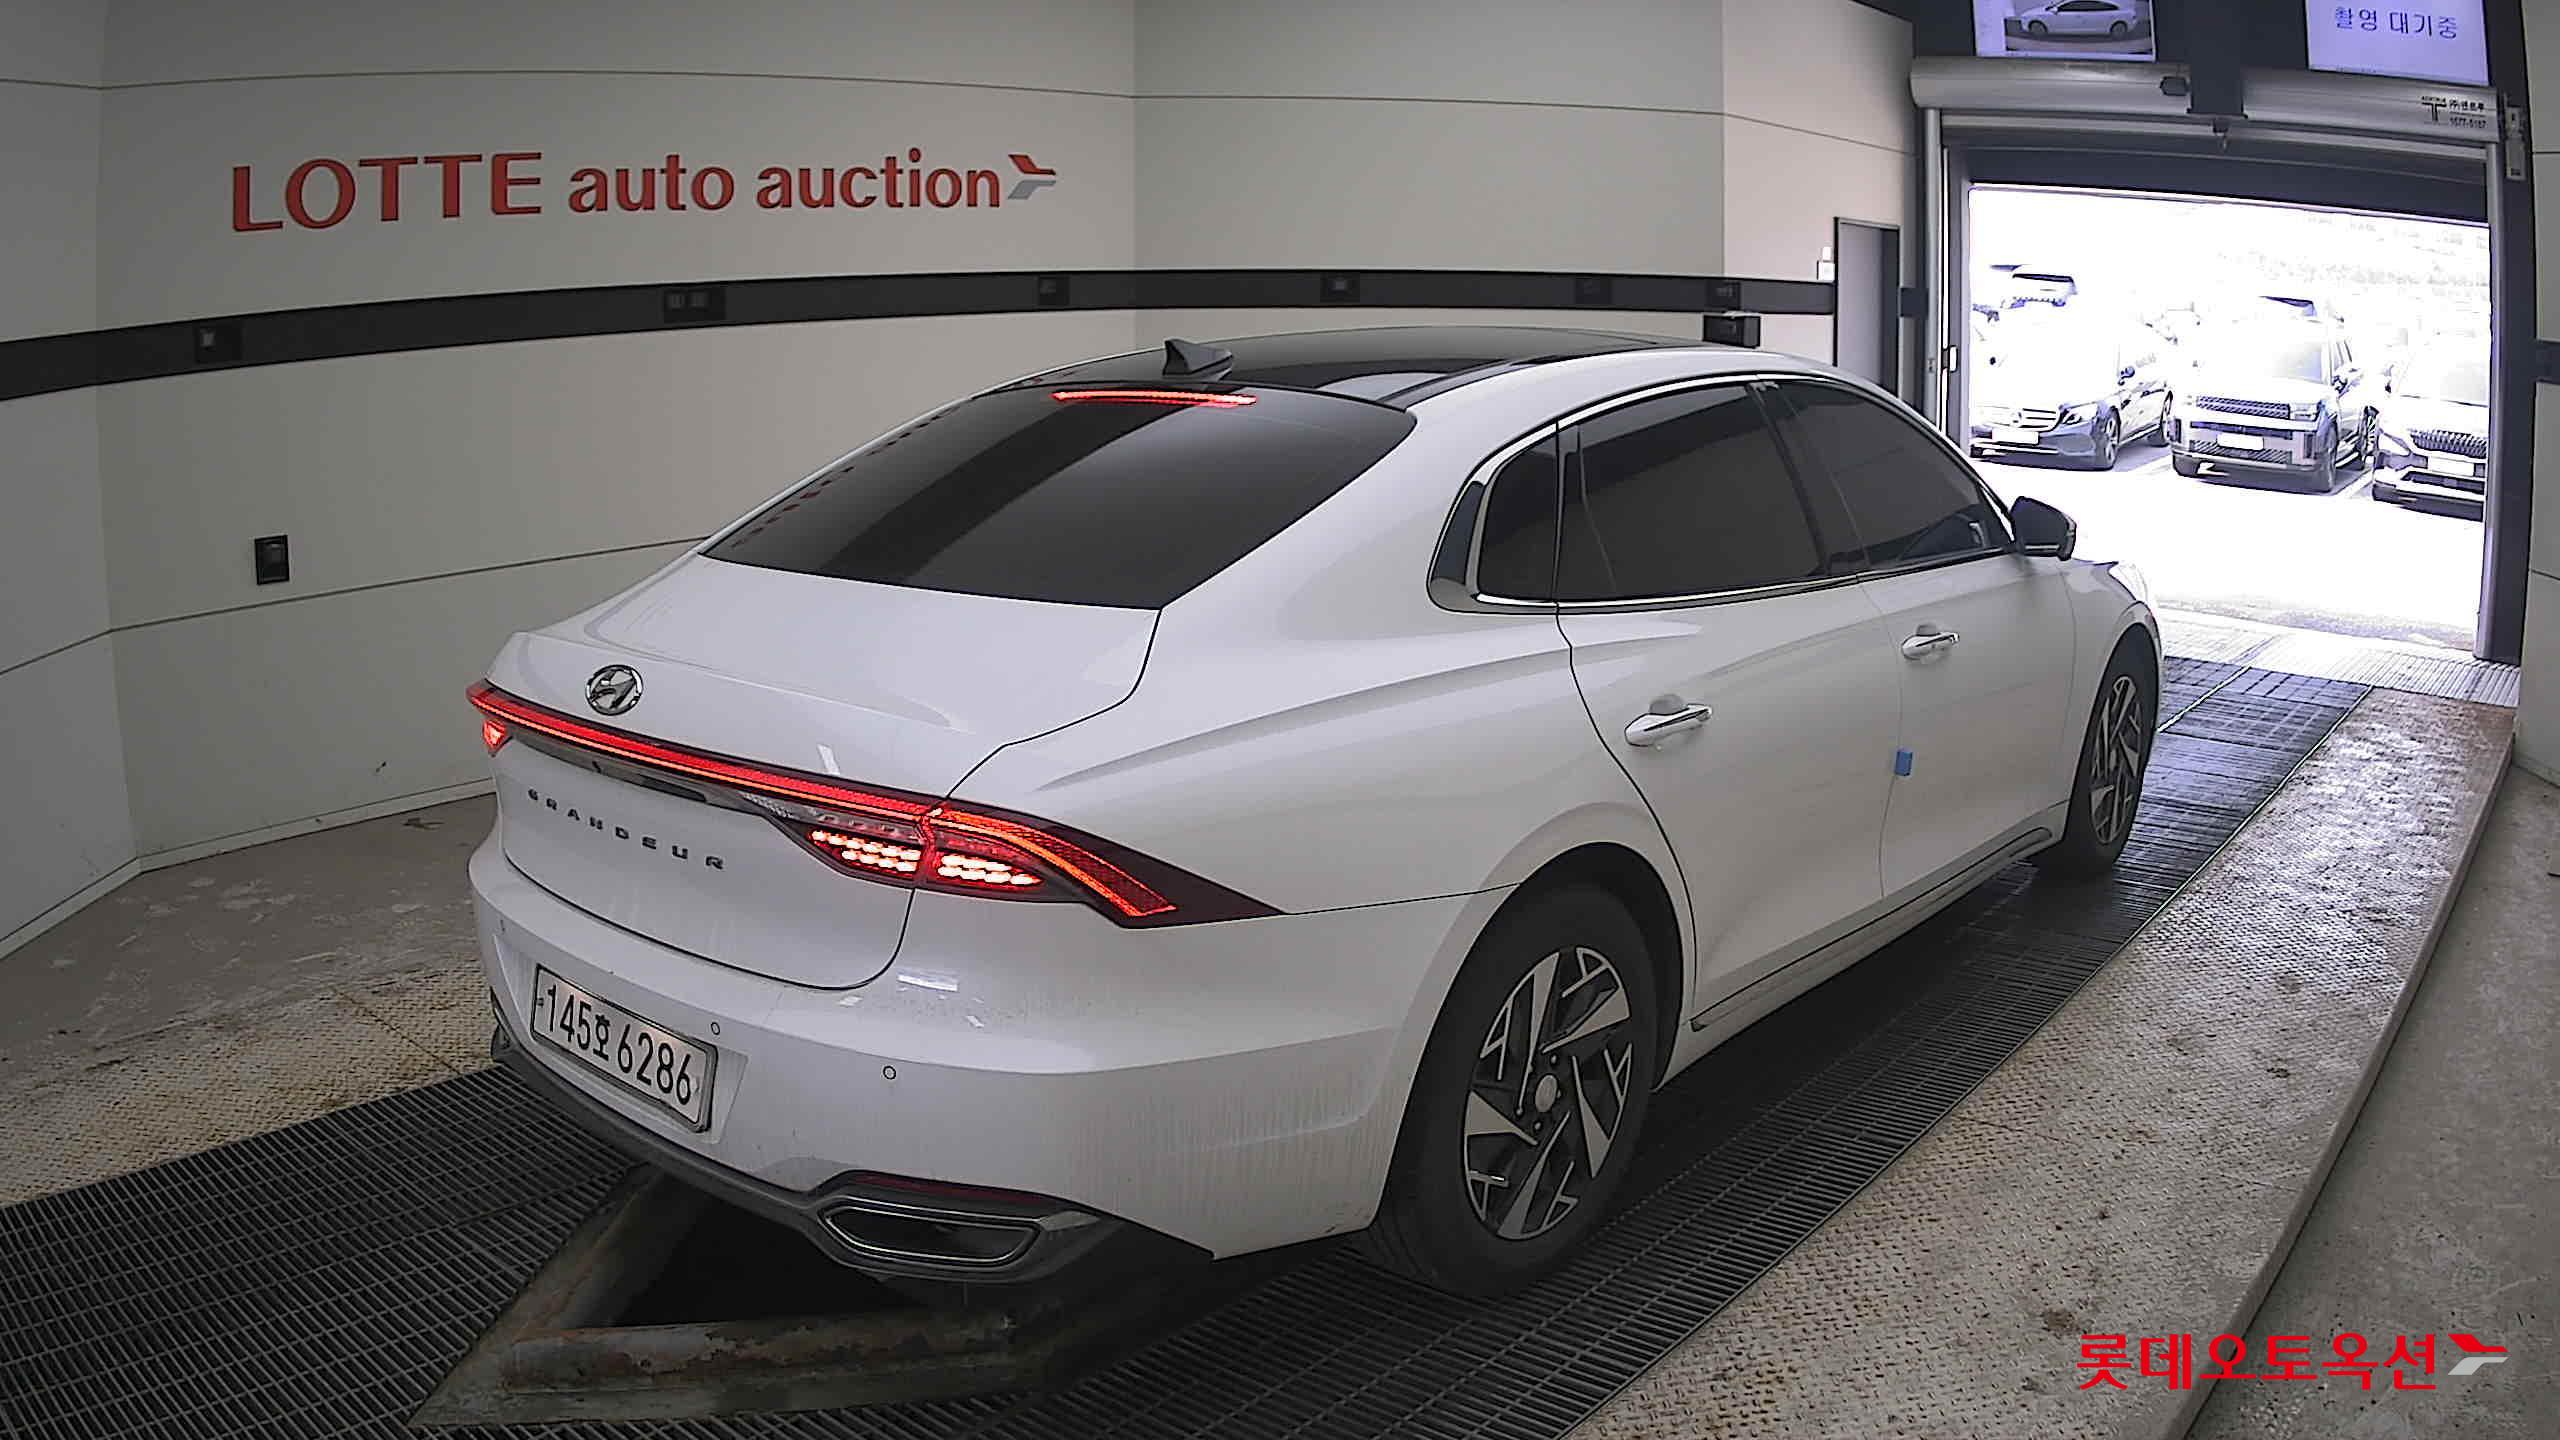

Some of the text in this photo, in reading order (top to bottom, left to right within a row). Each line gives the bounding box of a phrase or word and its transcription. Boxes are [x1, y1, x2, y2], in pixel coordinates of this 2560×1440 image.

[2335, 6, 2378, 32] 촬영
[232, 147, 1001, 232] LOTTE auto auction
[527, 788, 724, 870] GRANDEUR
